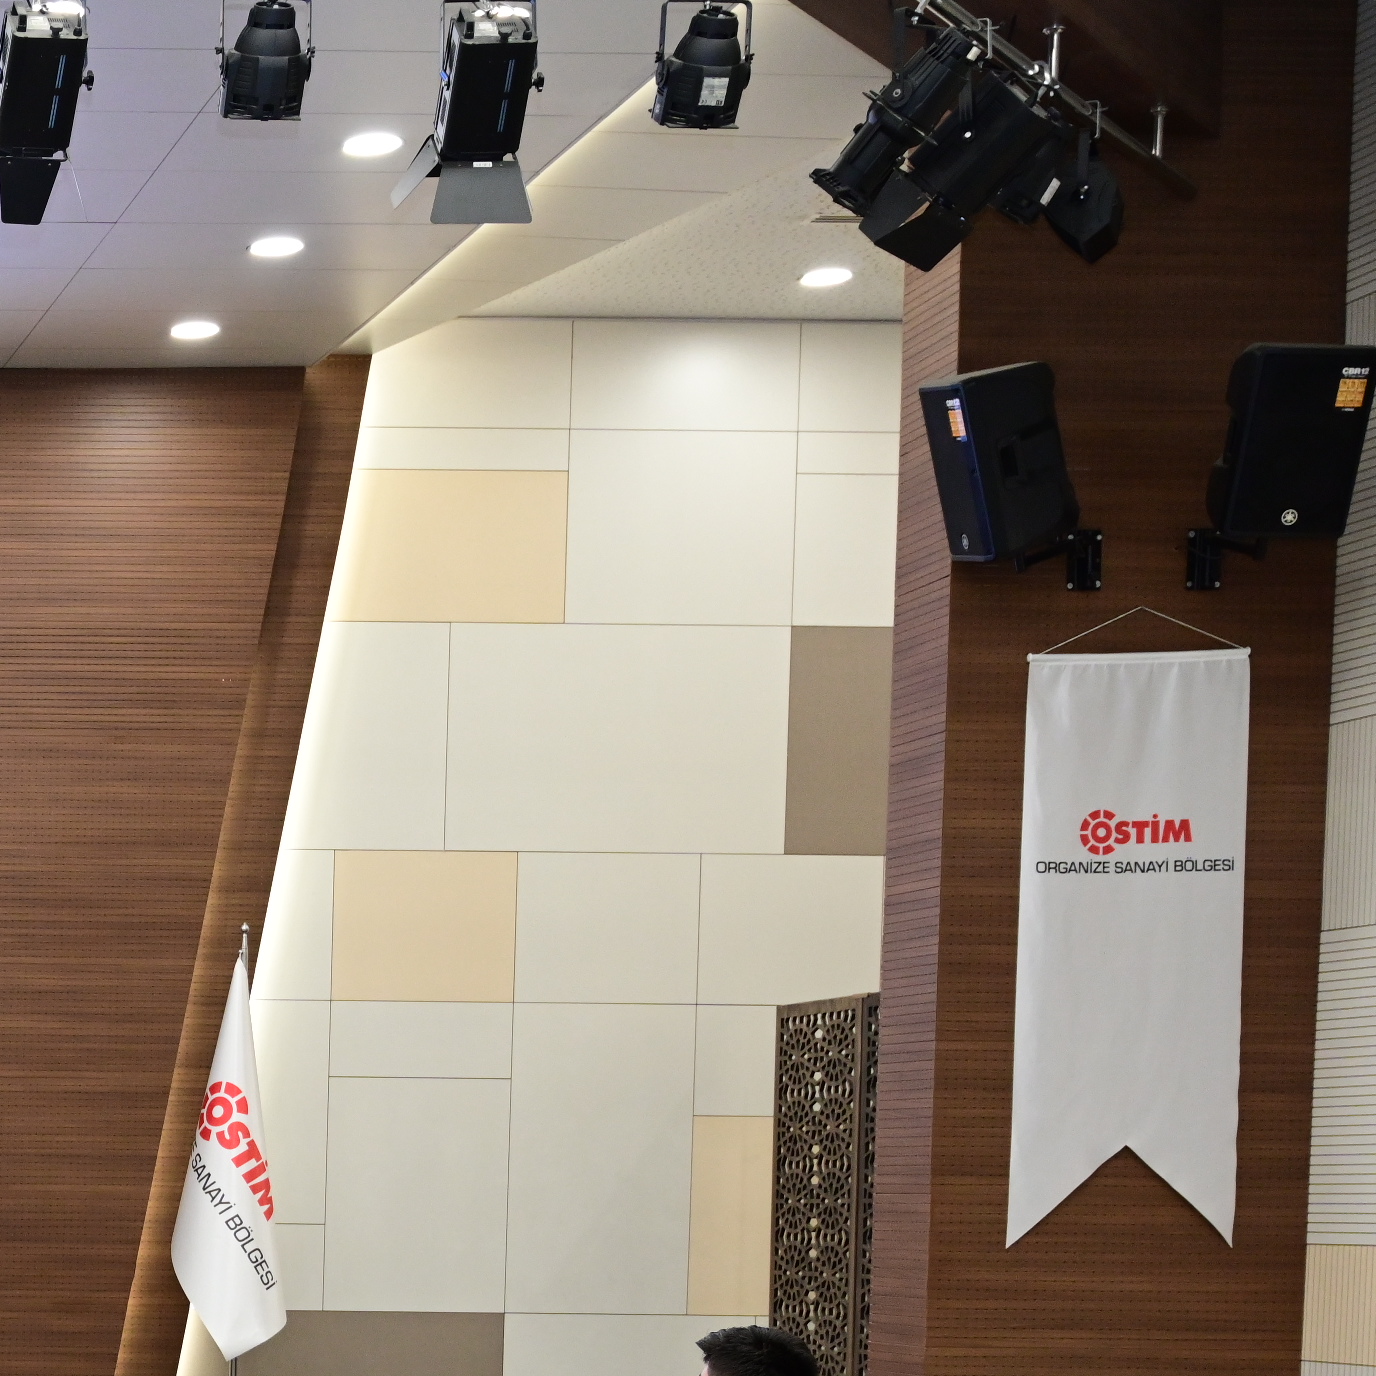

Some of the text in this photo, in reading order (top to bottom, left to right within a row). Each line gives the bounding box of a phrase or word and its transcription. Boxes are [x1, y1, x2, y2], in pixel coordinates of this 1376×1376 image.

[1087, 812, 1193, 849] OSTİM
[1035, 856, 1235, 875] ORGANİZE SANAYİ BÖLGESİ
[191, 1152, 278, 1291] SANAYİ BÖLGESİ
